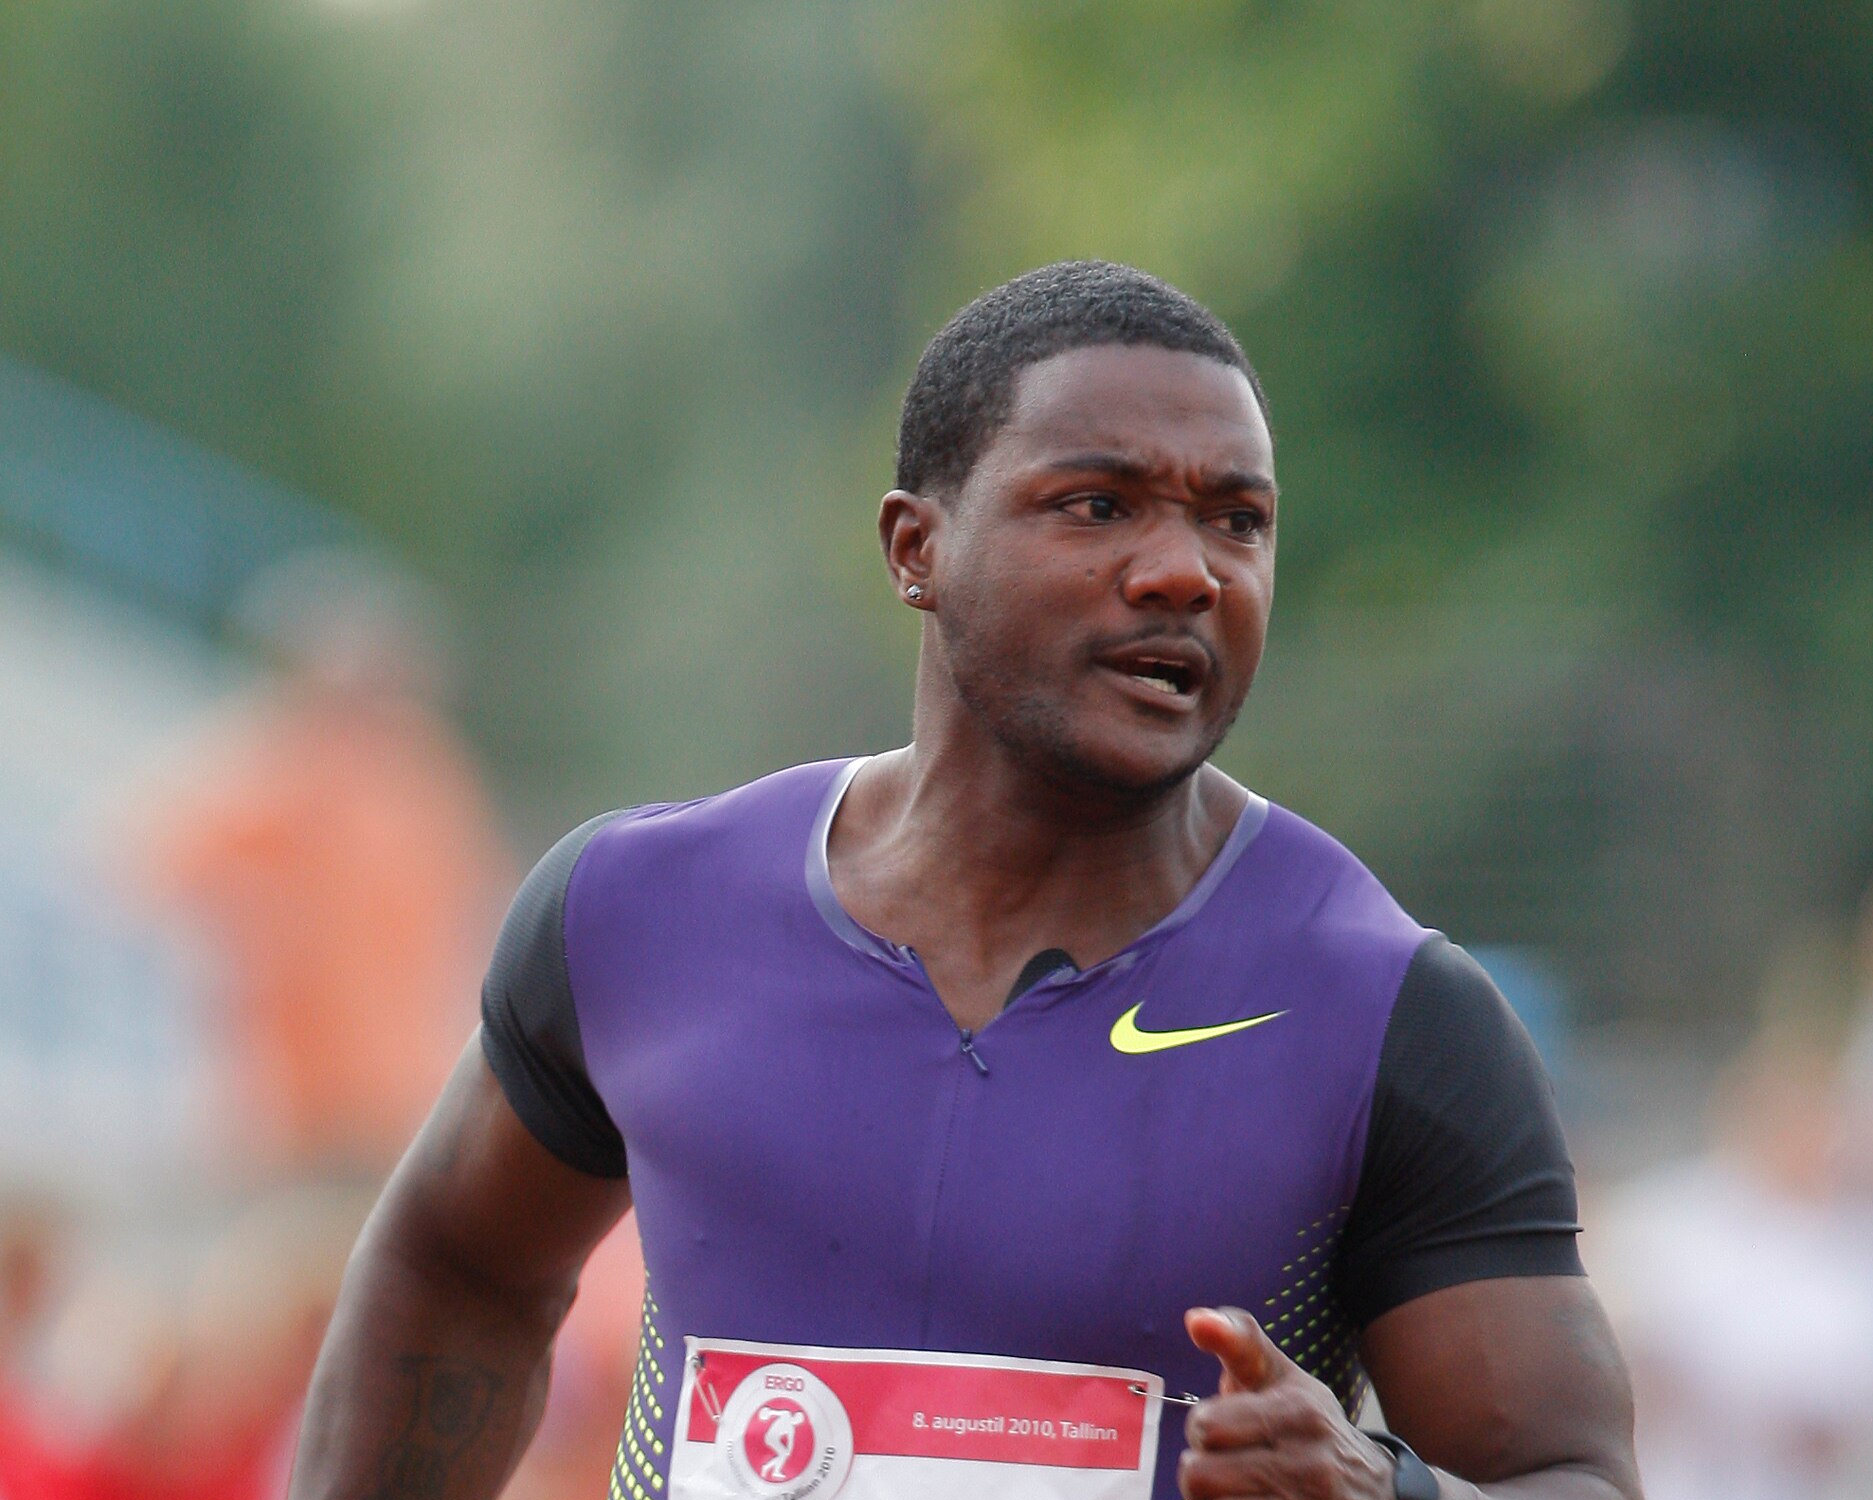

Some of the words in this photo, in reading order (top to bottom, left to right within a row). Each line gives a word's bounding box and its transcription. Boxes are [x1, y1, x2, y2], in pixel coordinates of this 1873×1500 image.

[765, 1375, 805, 1392] ERGO
[912, 1412, 929, 1429] 8.
[932, 1415, 1004, 1434] augustil
[1009, 1418, 1056, 1439] 2010,
[1060, 1421, 1118, 1441] Tallinn
[817, 1446, 836, 1479] 2010
